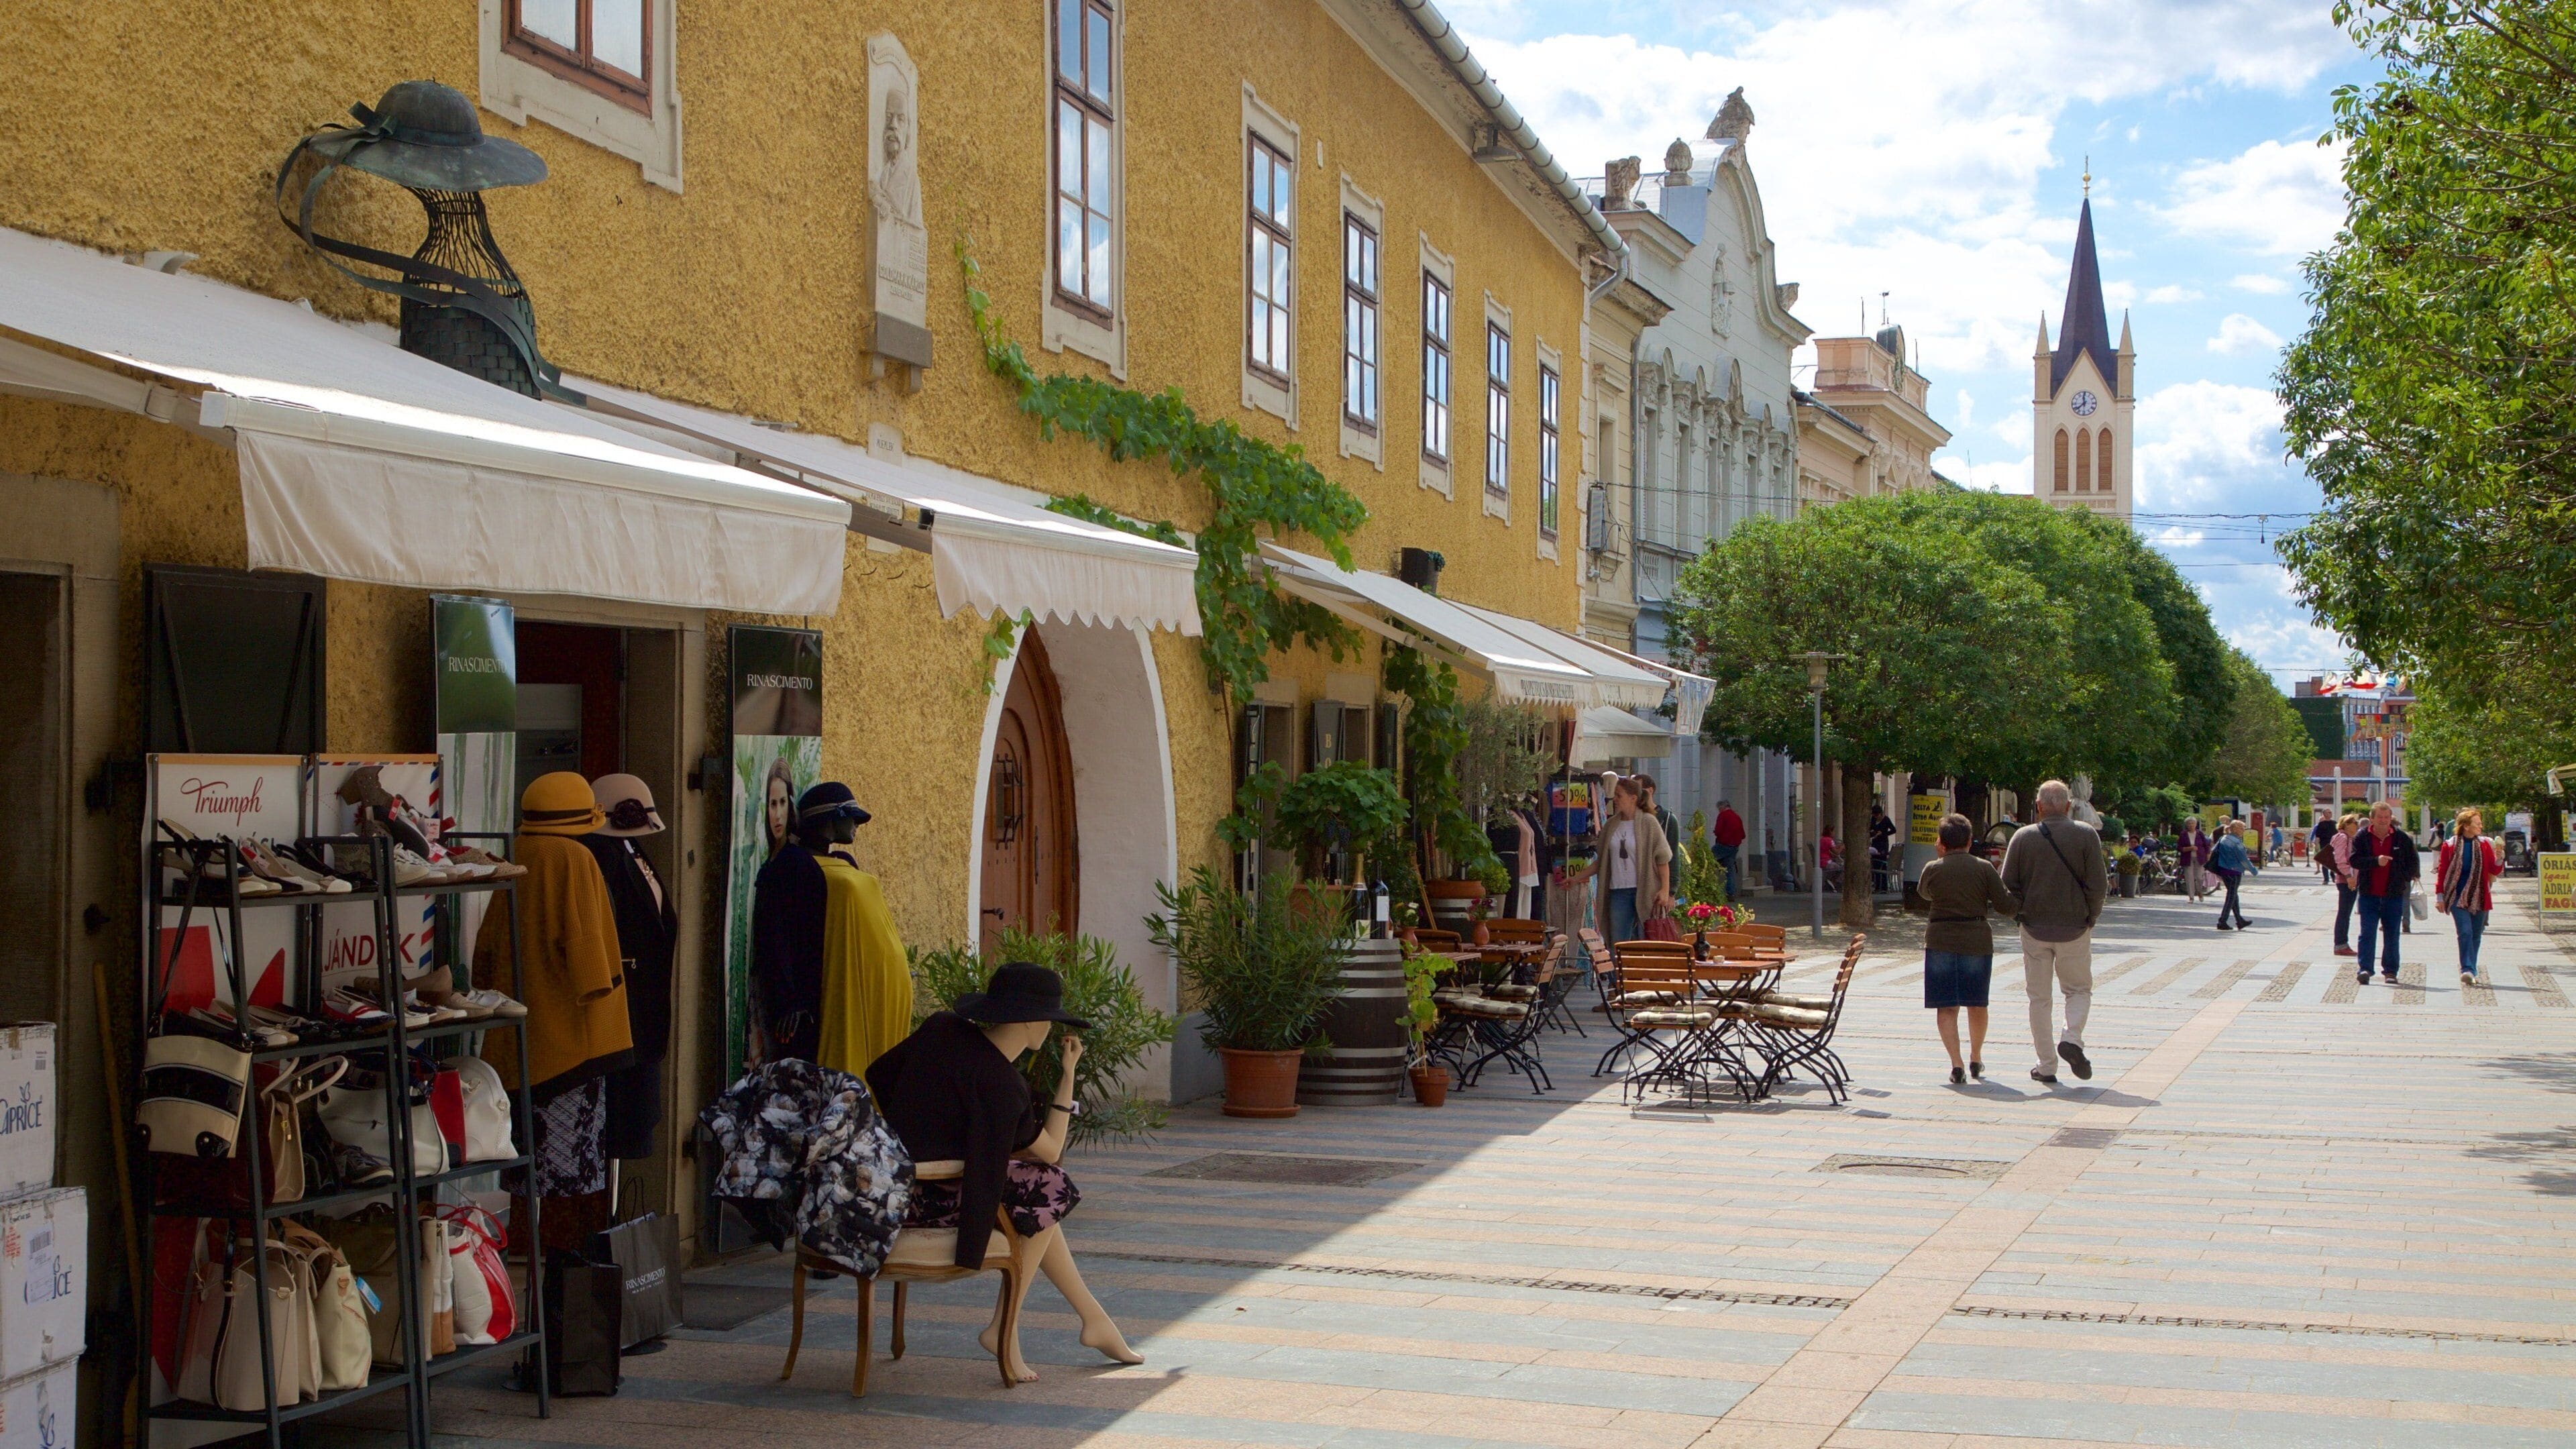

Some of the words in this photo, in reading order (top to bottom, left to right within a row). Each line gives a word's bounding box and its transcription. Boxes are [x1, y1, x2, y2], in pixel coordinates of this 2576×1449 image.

[448, 656, 507, 674] RINASCIMENTO
[746, 673, 814, 690] RINASCIMENTO
[180, 776, 264, 827] Triumph
[321, 928, 415, 973] JÁNDK
[625, 1267, 665, 1290] RINASCIMENTO
